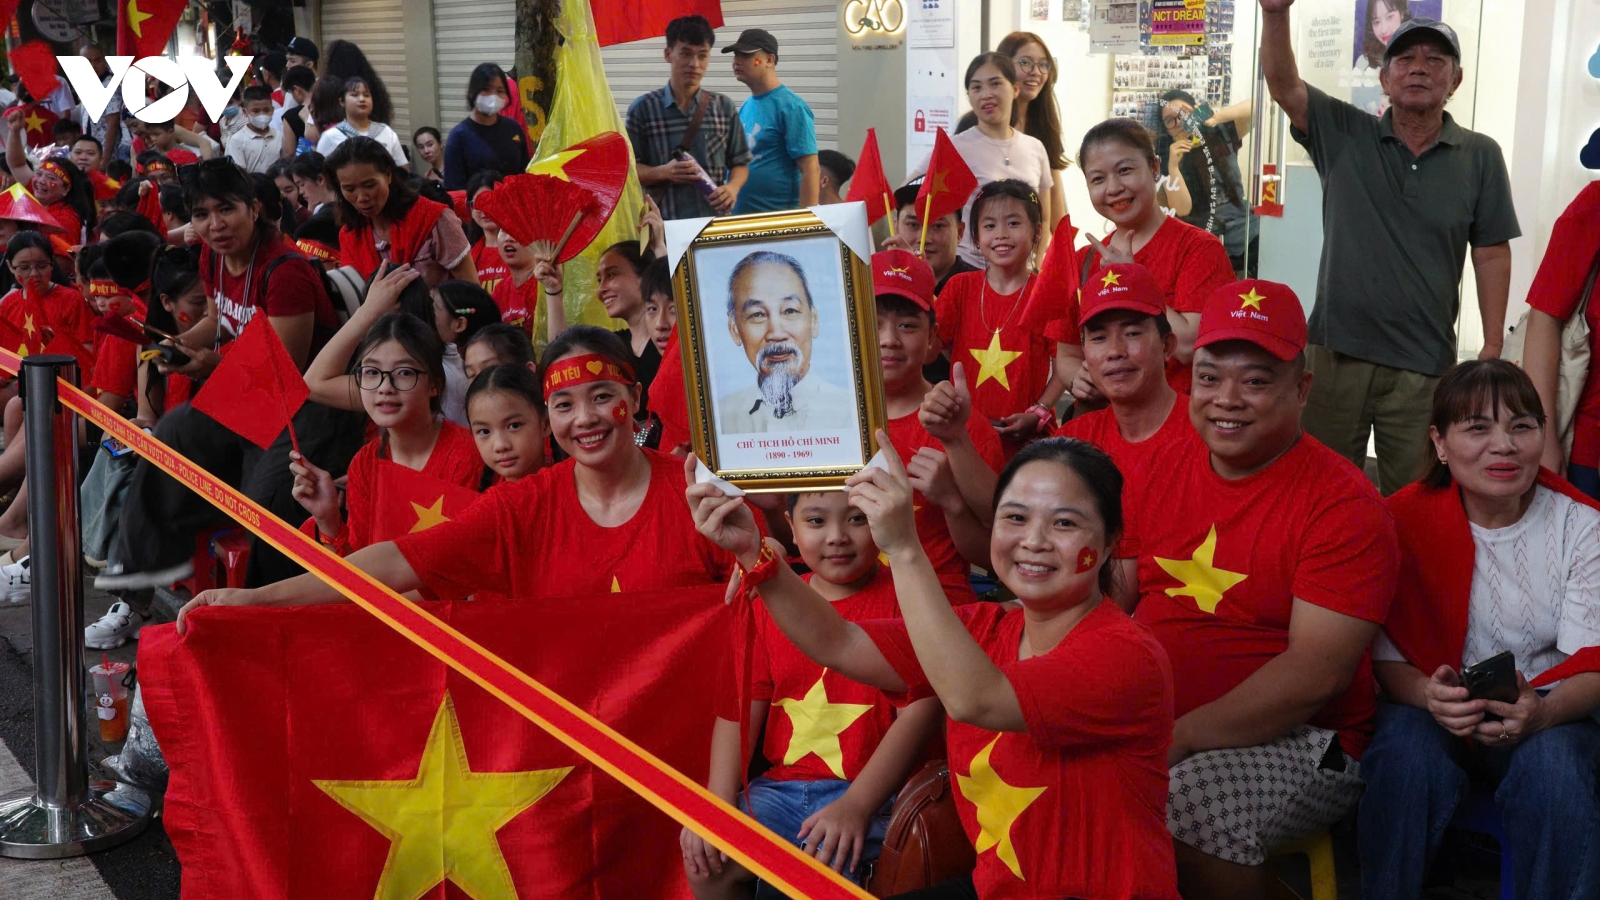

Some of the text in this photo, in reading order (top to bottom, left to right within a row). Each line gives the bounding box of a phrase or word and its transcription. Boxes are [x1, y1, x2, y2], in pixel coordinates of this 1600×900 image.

[1153, 9, 1205, 22] NCT DREAM
[1311, 17, 1330, 27] always
[1309, 27, 1342, 38] the first time
[1314, 38, 1336, 49] capture
[1309, 49, 1342, 59] the memory
[1314, 59, 1320, 68] of
[1324, 59, 1336, 69] day
[1112, 285, 1128, 293] Nam
[1230, 309, 1269, 322] Việt Nam
[551, 370, 562, 386] TÔI
[562, 365, 581, 381] YÊU
[737, 435, 840, 450] CHỦ TỊCH HỒ CHÍ MINH
[765, 451, 786, 460] (1890
[793, 449, 813, 458] 1969)
[179, 463, 199, 486] POLICE
[214, 487, 224, 503] DO
[224, 493, 238, 512] NOT
[238, 503, 261, 527] CROSS
